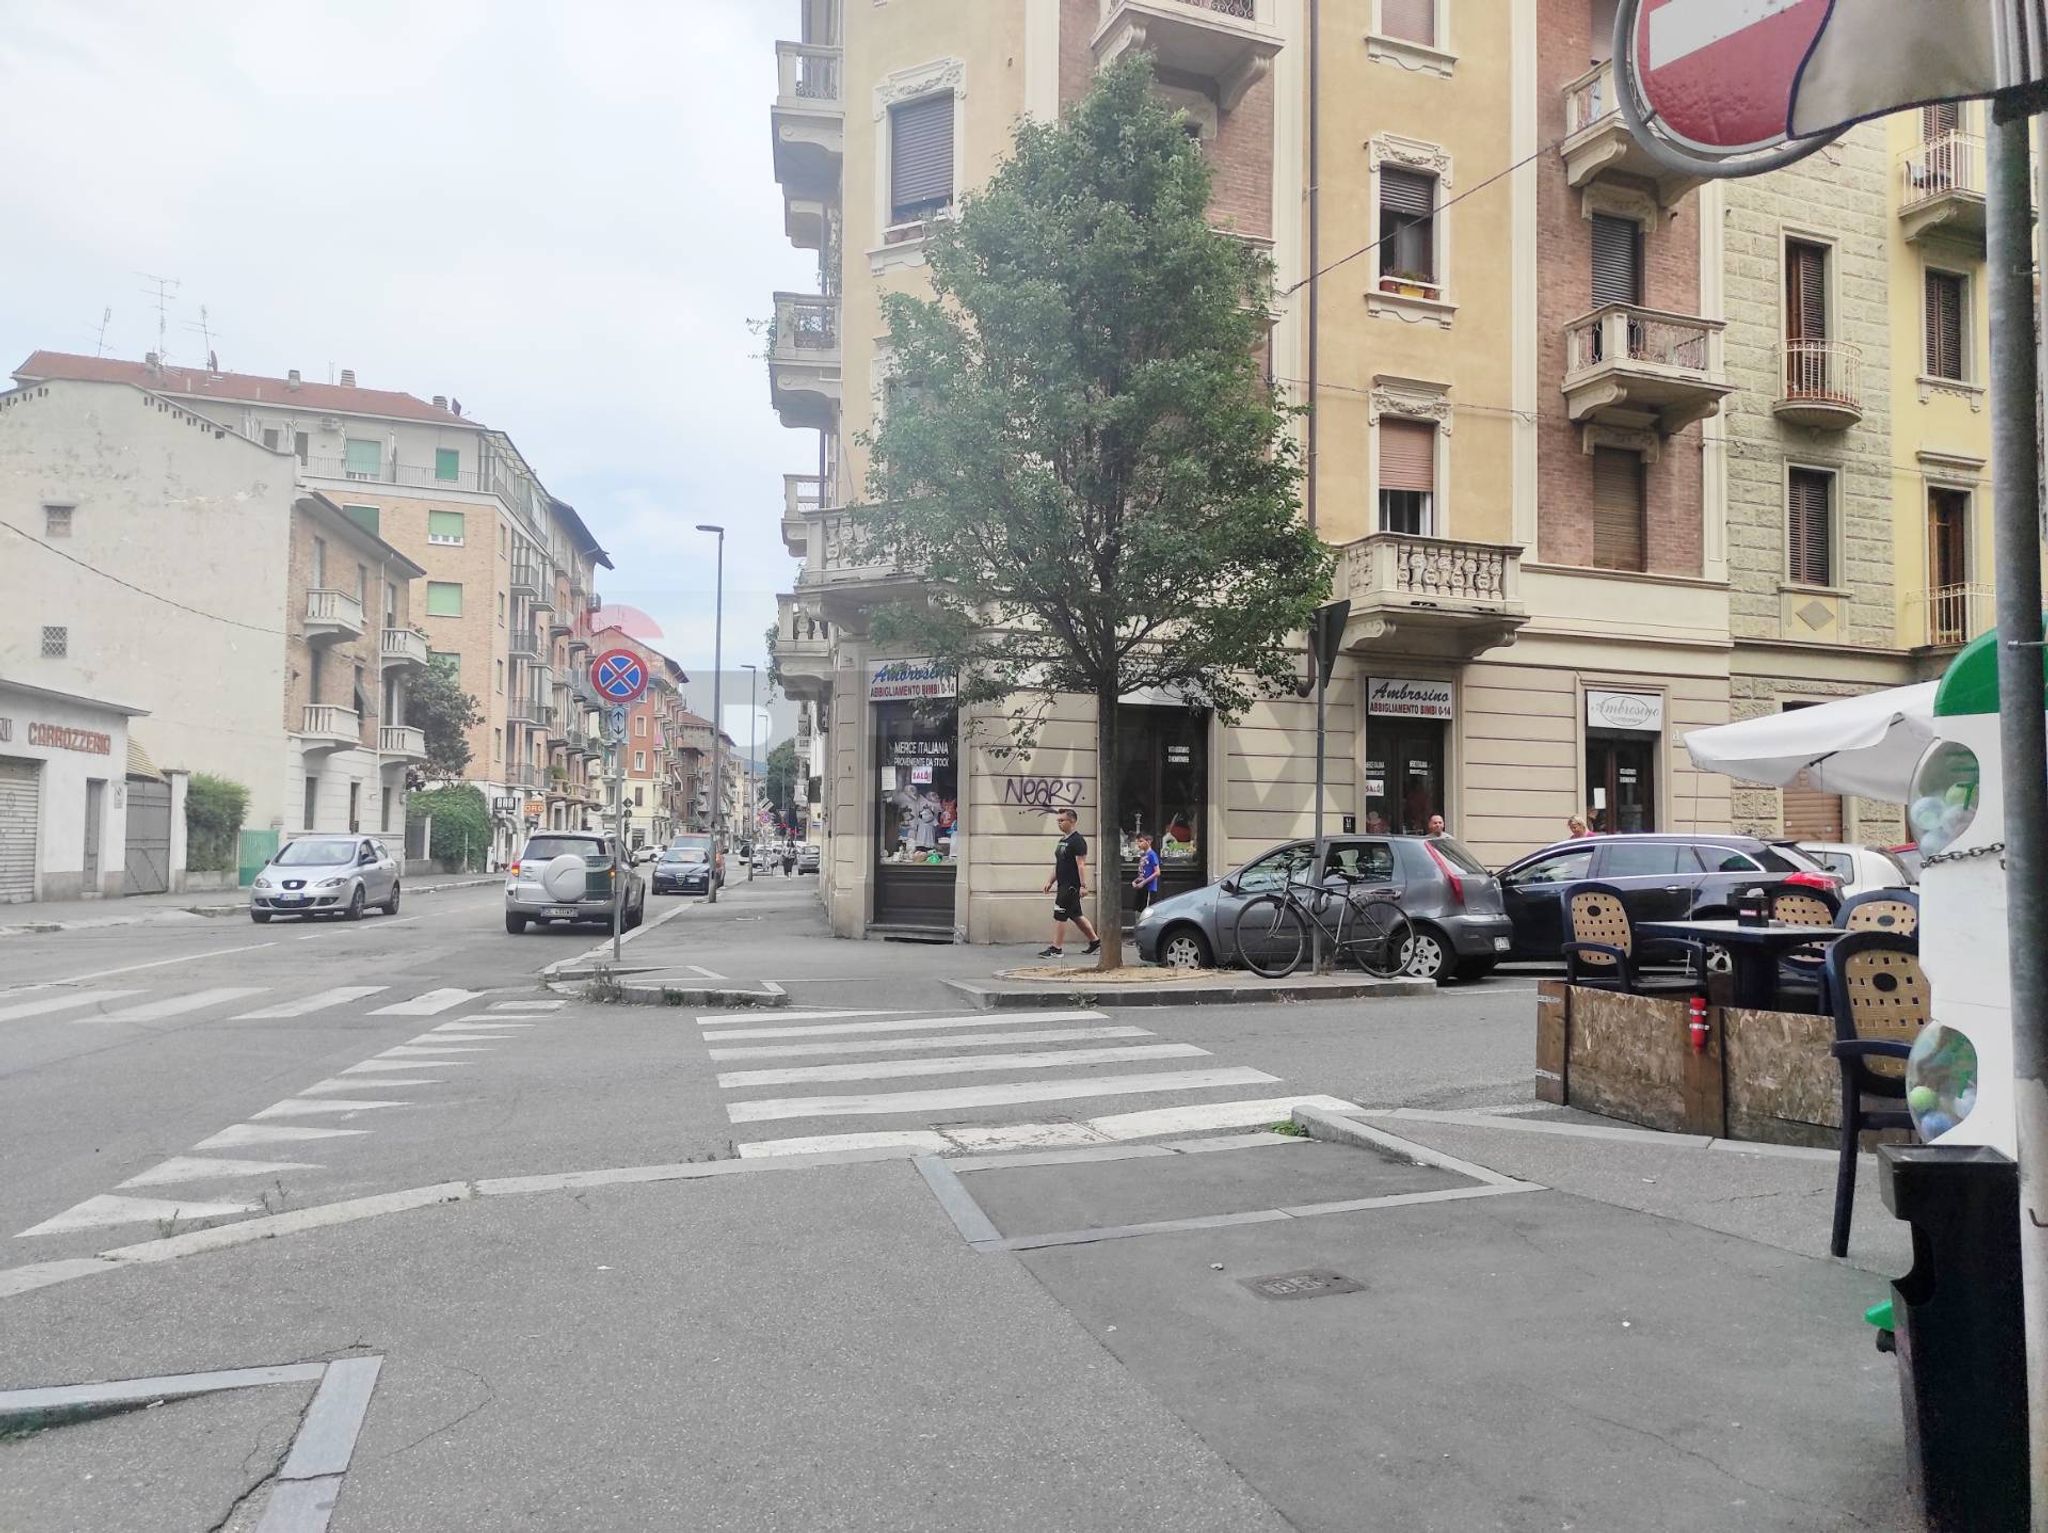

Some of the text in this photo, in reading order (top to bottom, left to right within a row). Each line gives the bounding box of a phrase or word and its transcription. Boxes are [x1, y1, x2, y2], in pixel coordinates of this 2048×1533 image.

[871, 684, 921, 698] ABBIGLIAMENTO
[922, 683, 940, 697] BIMBI
[1372, 681, 1450, 702] Ambrosino
[1370, 702, 1451, 716] ABBIGLIAMENTO BIMBI 0-14
[1591, 698, 1659, 717] Ambrosino
[28, 722, 112, 756] CARROZZERIA
[894, 741, 949, 755] MERCE ITALIANA
[894, 757, 950, 767] PROVENIENTE DA STOCK
